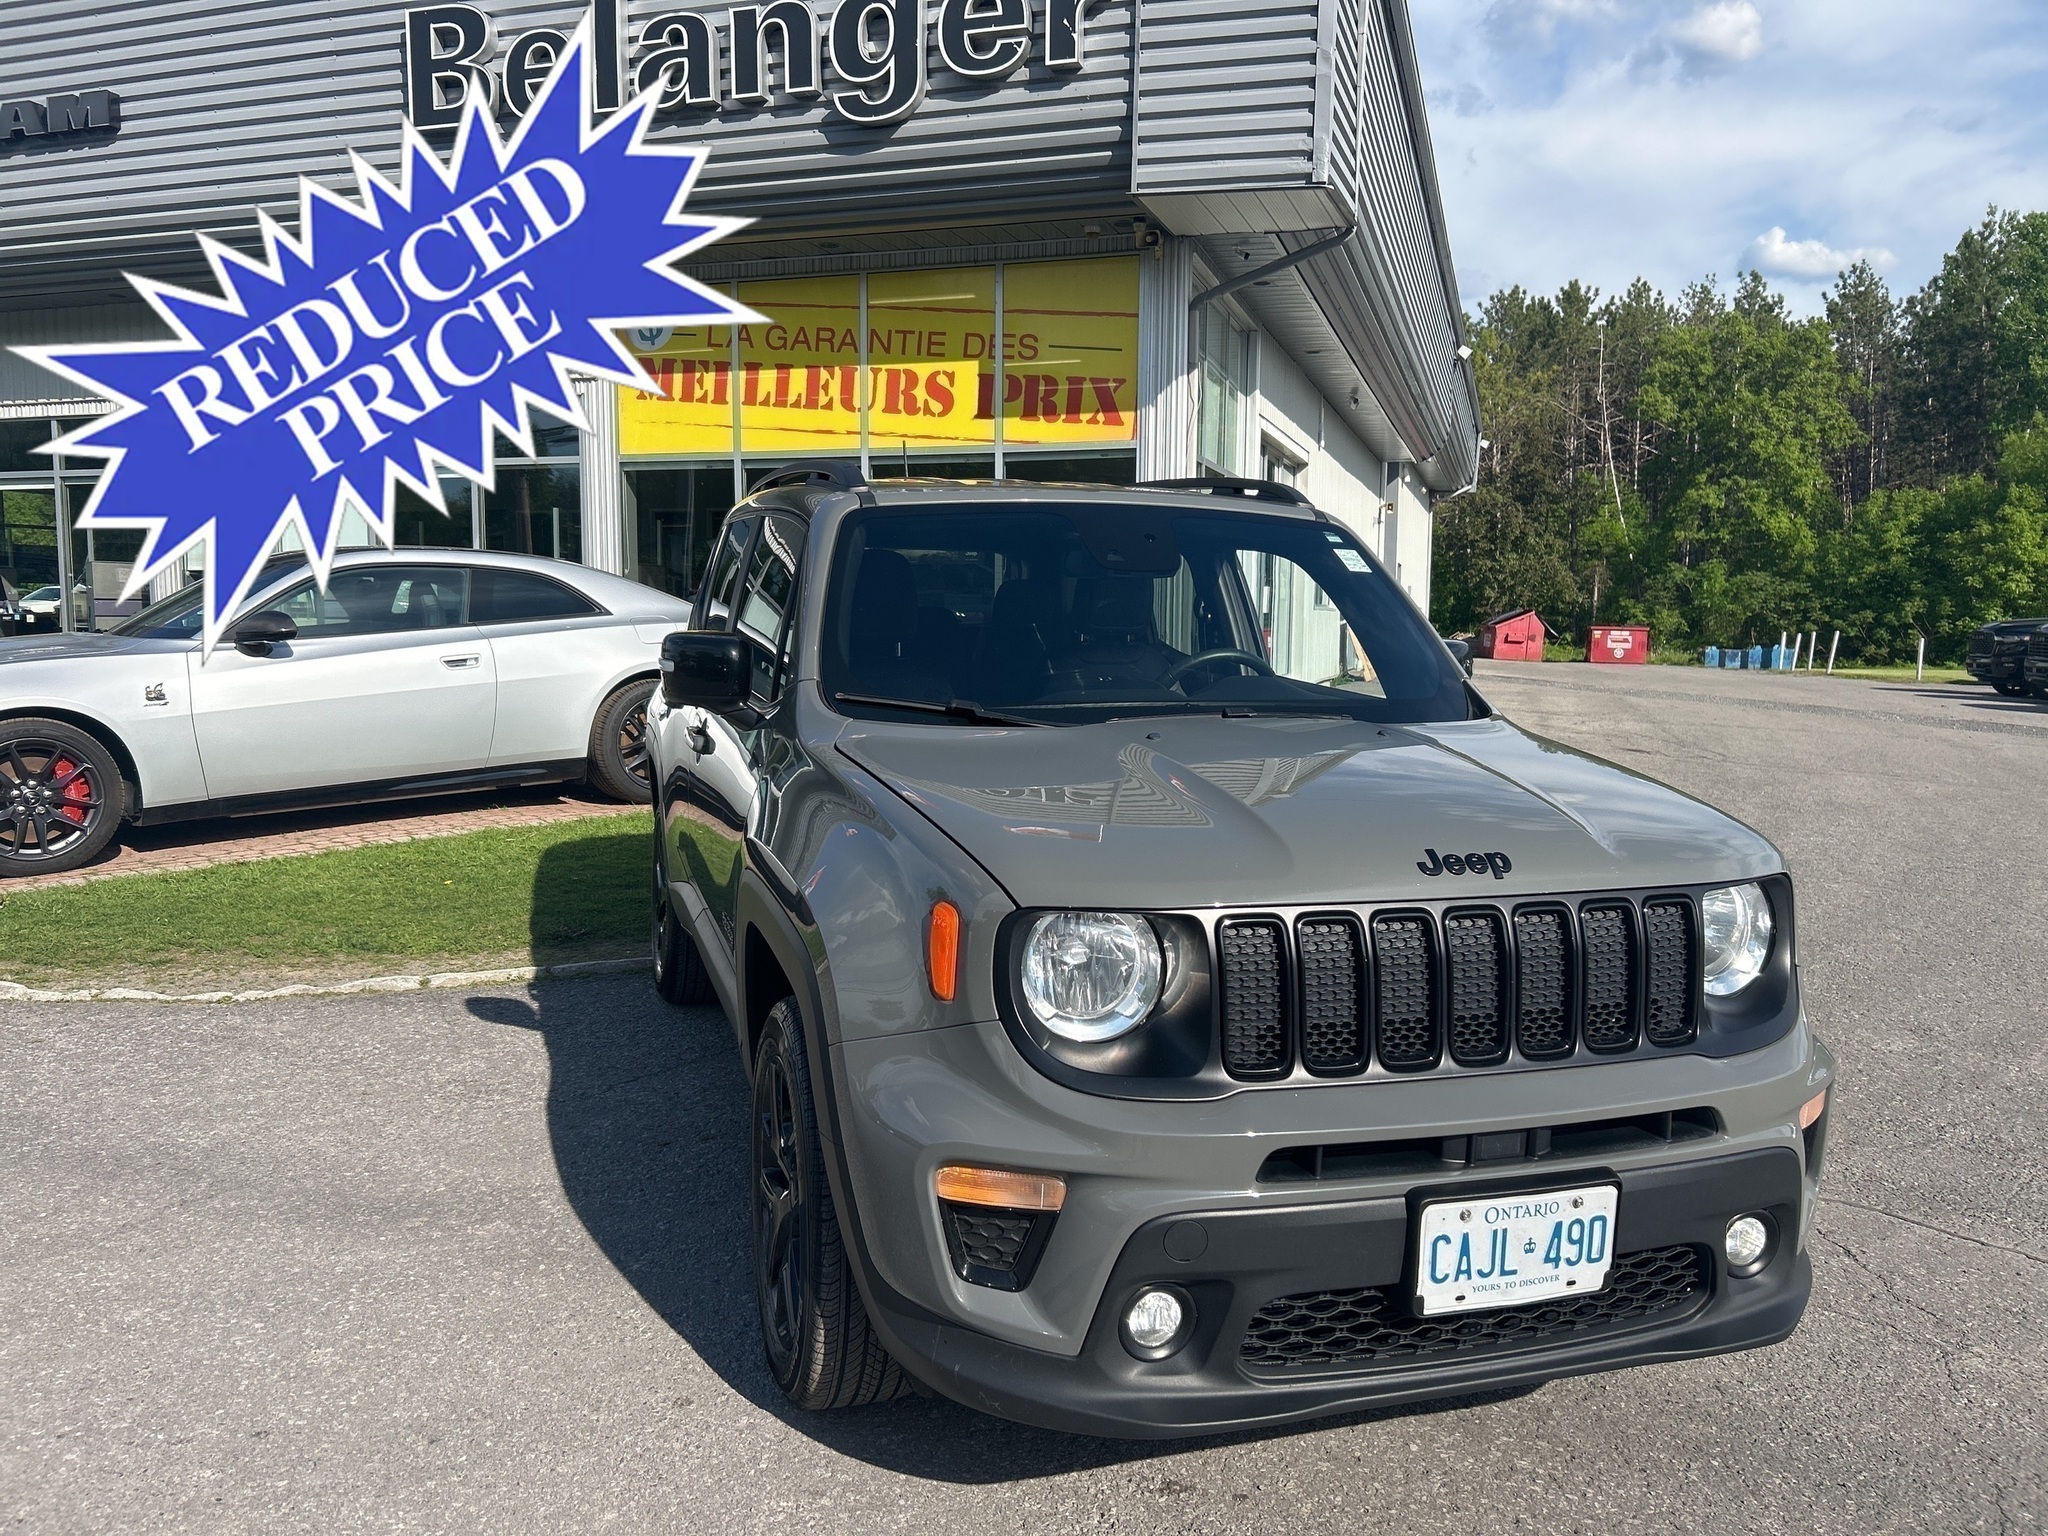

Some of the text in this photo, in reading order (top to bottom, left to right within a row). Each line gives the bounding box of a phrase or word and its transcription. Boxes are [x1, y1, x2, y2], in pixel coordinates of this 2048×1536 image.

[404, 0, 1086, 125] Belanger
[706, 323, 1040, 361] LA GARANTIE DES
[636, 356, 1127, 427] MEILLEURS PRIX
[1416, 848, 1512, 880] Jeep
[1484, 1201, 1560, 1225] ONTARIO
[1429, 1214, 1608, 1285] CAJL 490
[1471, 1273, 1561, 1294] YOURS TO DISCOVER
